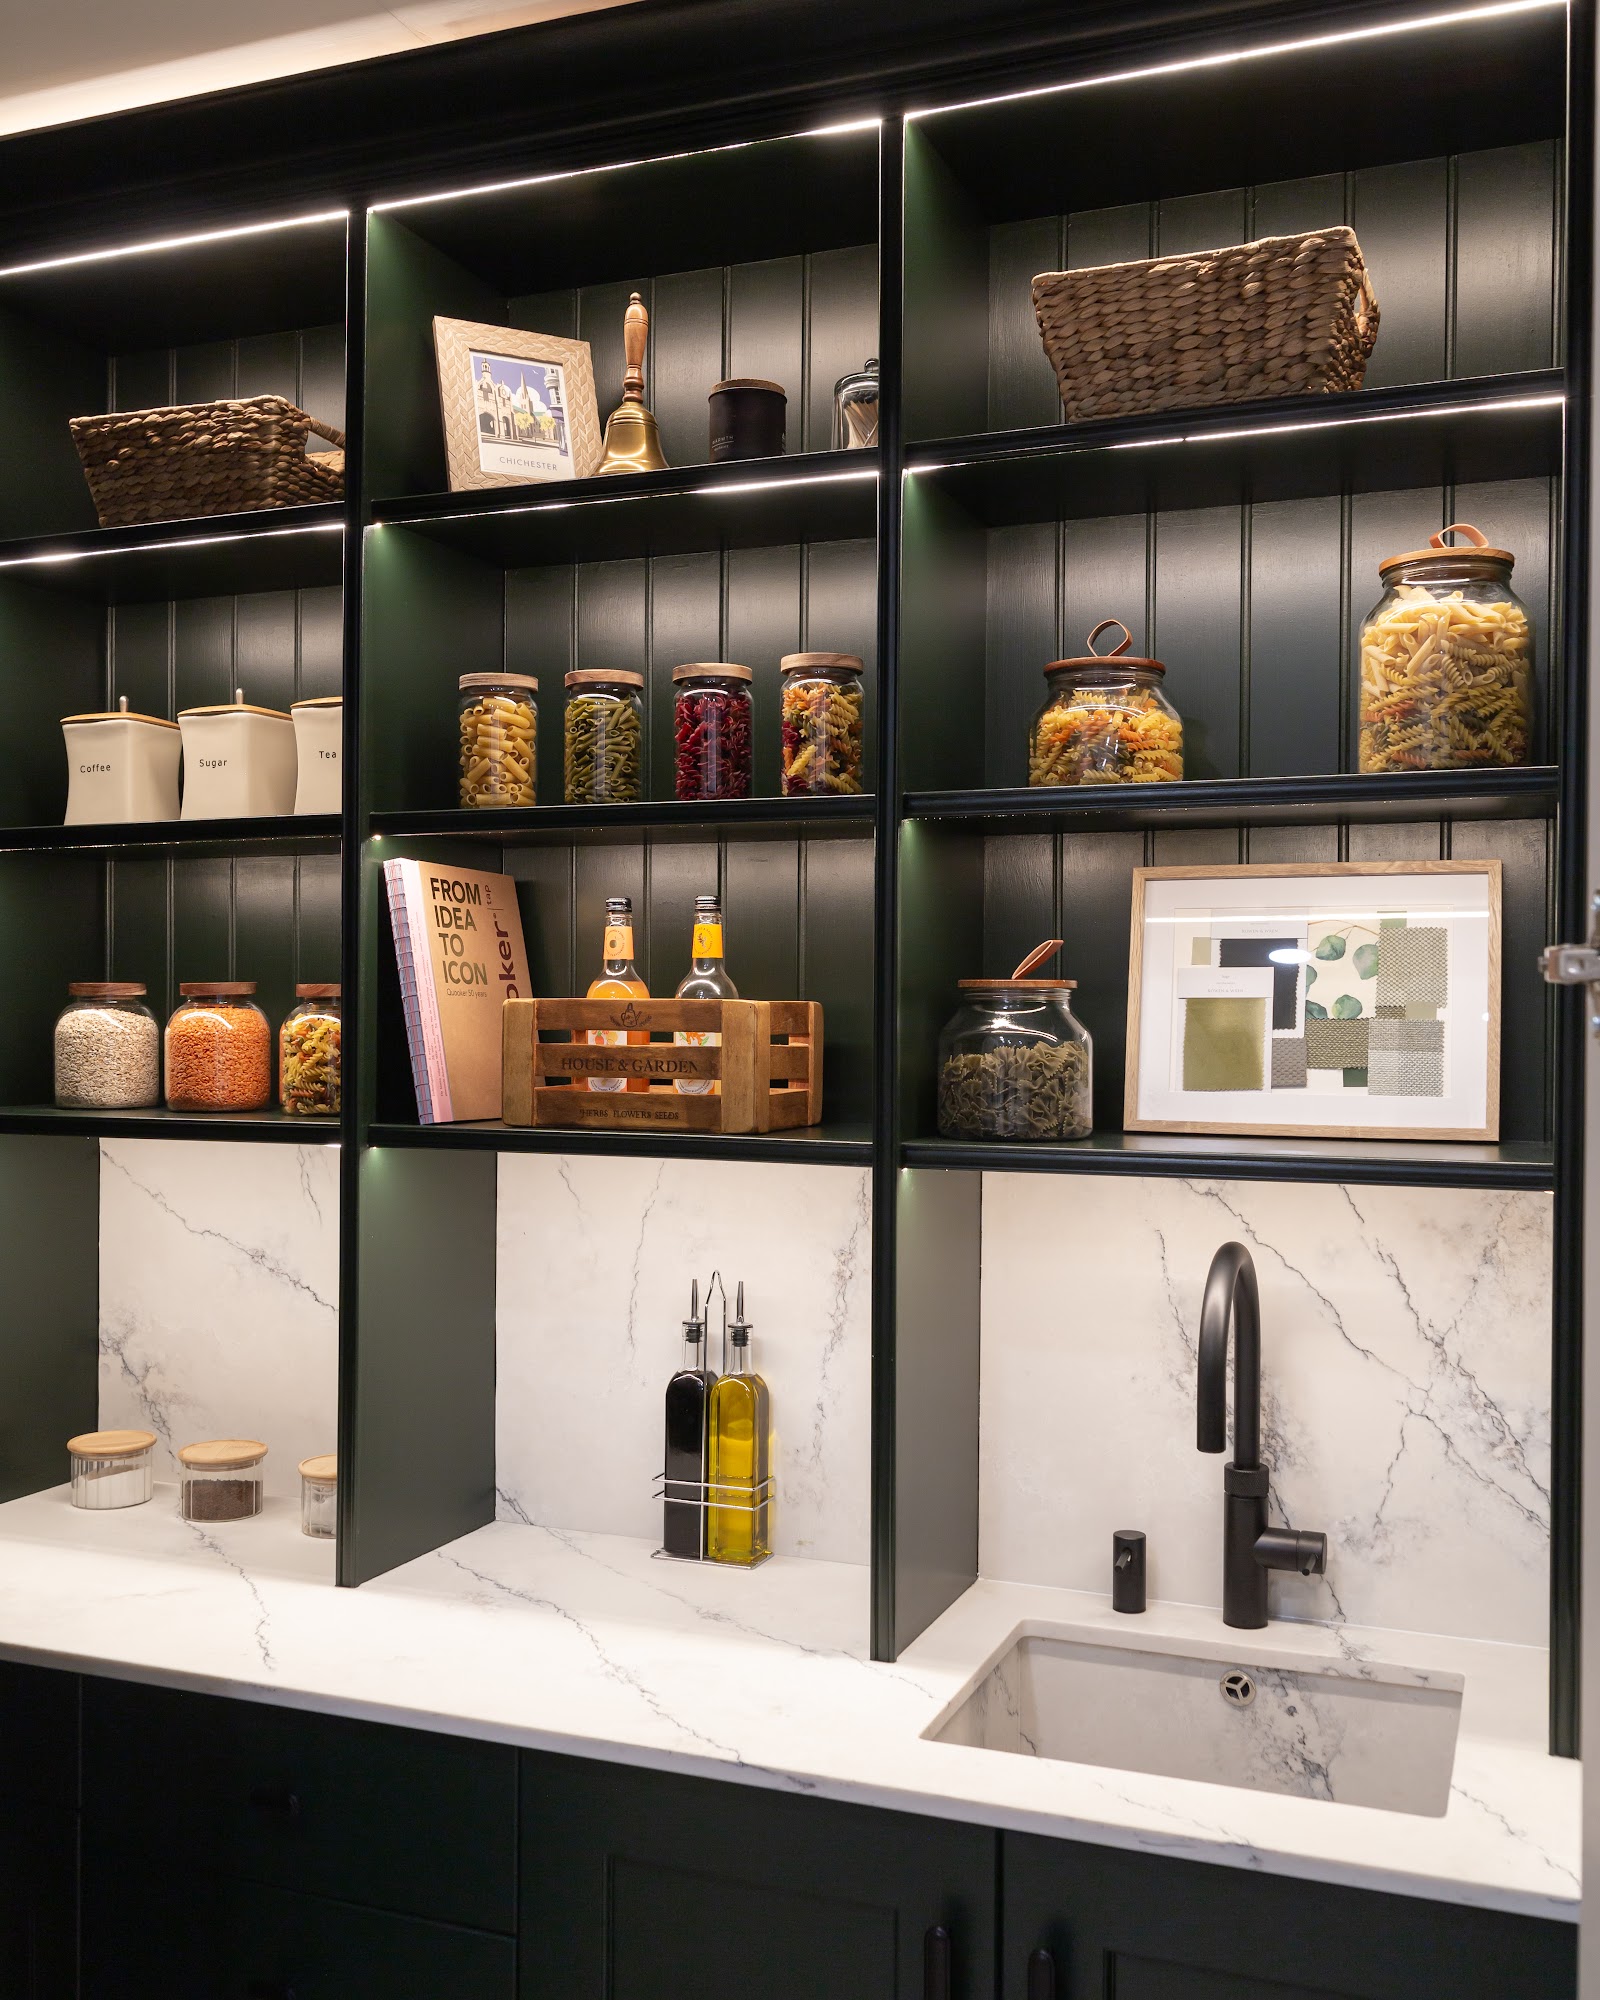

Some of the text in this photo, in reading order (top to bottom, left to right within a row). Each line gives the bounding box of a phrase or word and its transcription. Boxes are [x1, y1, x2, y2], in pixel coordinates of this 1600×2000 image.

[499, 456, 558, 471] CHICHESTER
[318, 750, 337, 759] Tea
[79, 763, 111, 774] Coffee
[199, 758, 228, 769] Sugar
[430, 877, 482, 906] FROM
[485, 885, 493, 905] tap
[434, 904, 478, 932] IDEA
[438, 932, 465, 957] TO
[442, 960, 488, 986] ICON
[468, 989, 475, 998] 50
[475, 990, 488, 999] years
[561, 1057, 698, 1073] HOUSE & GARDEN
[579, 1109, 609, 1119] HERBS
[613, 1110, 651, 1119] FLOWERS
